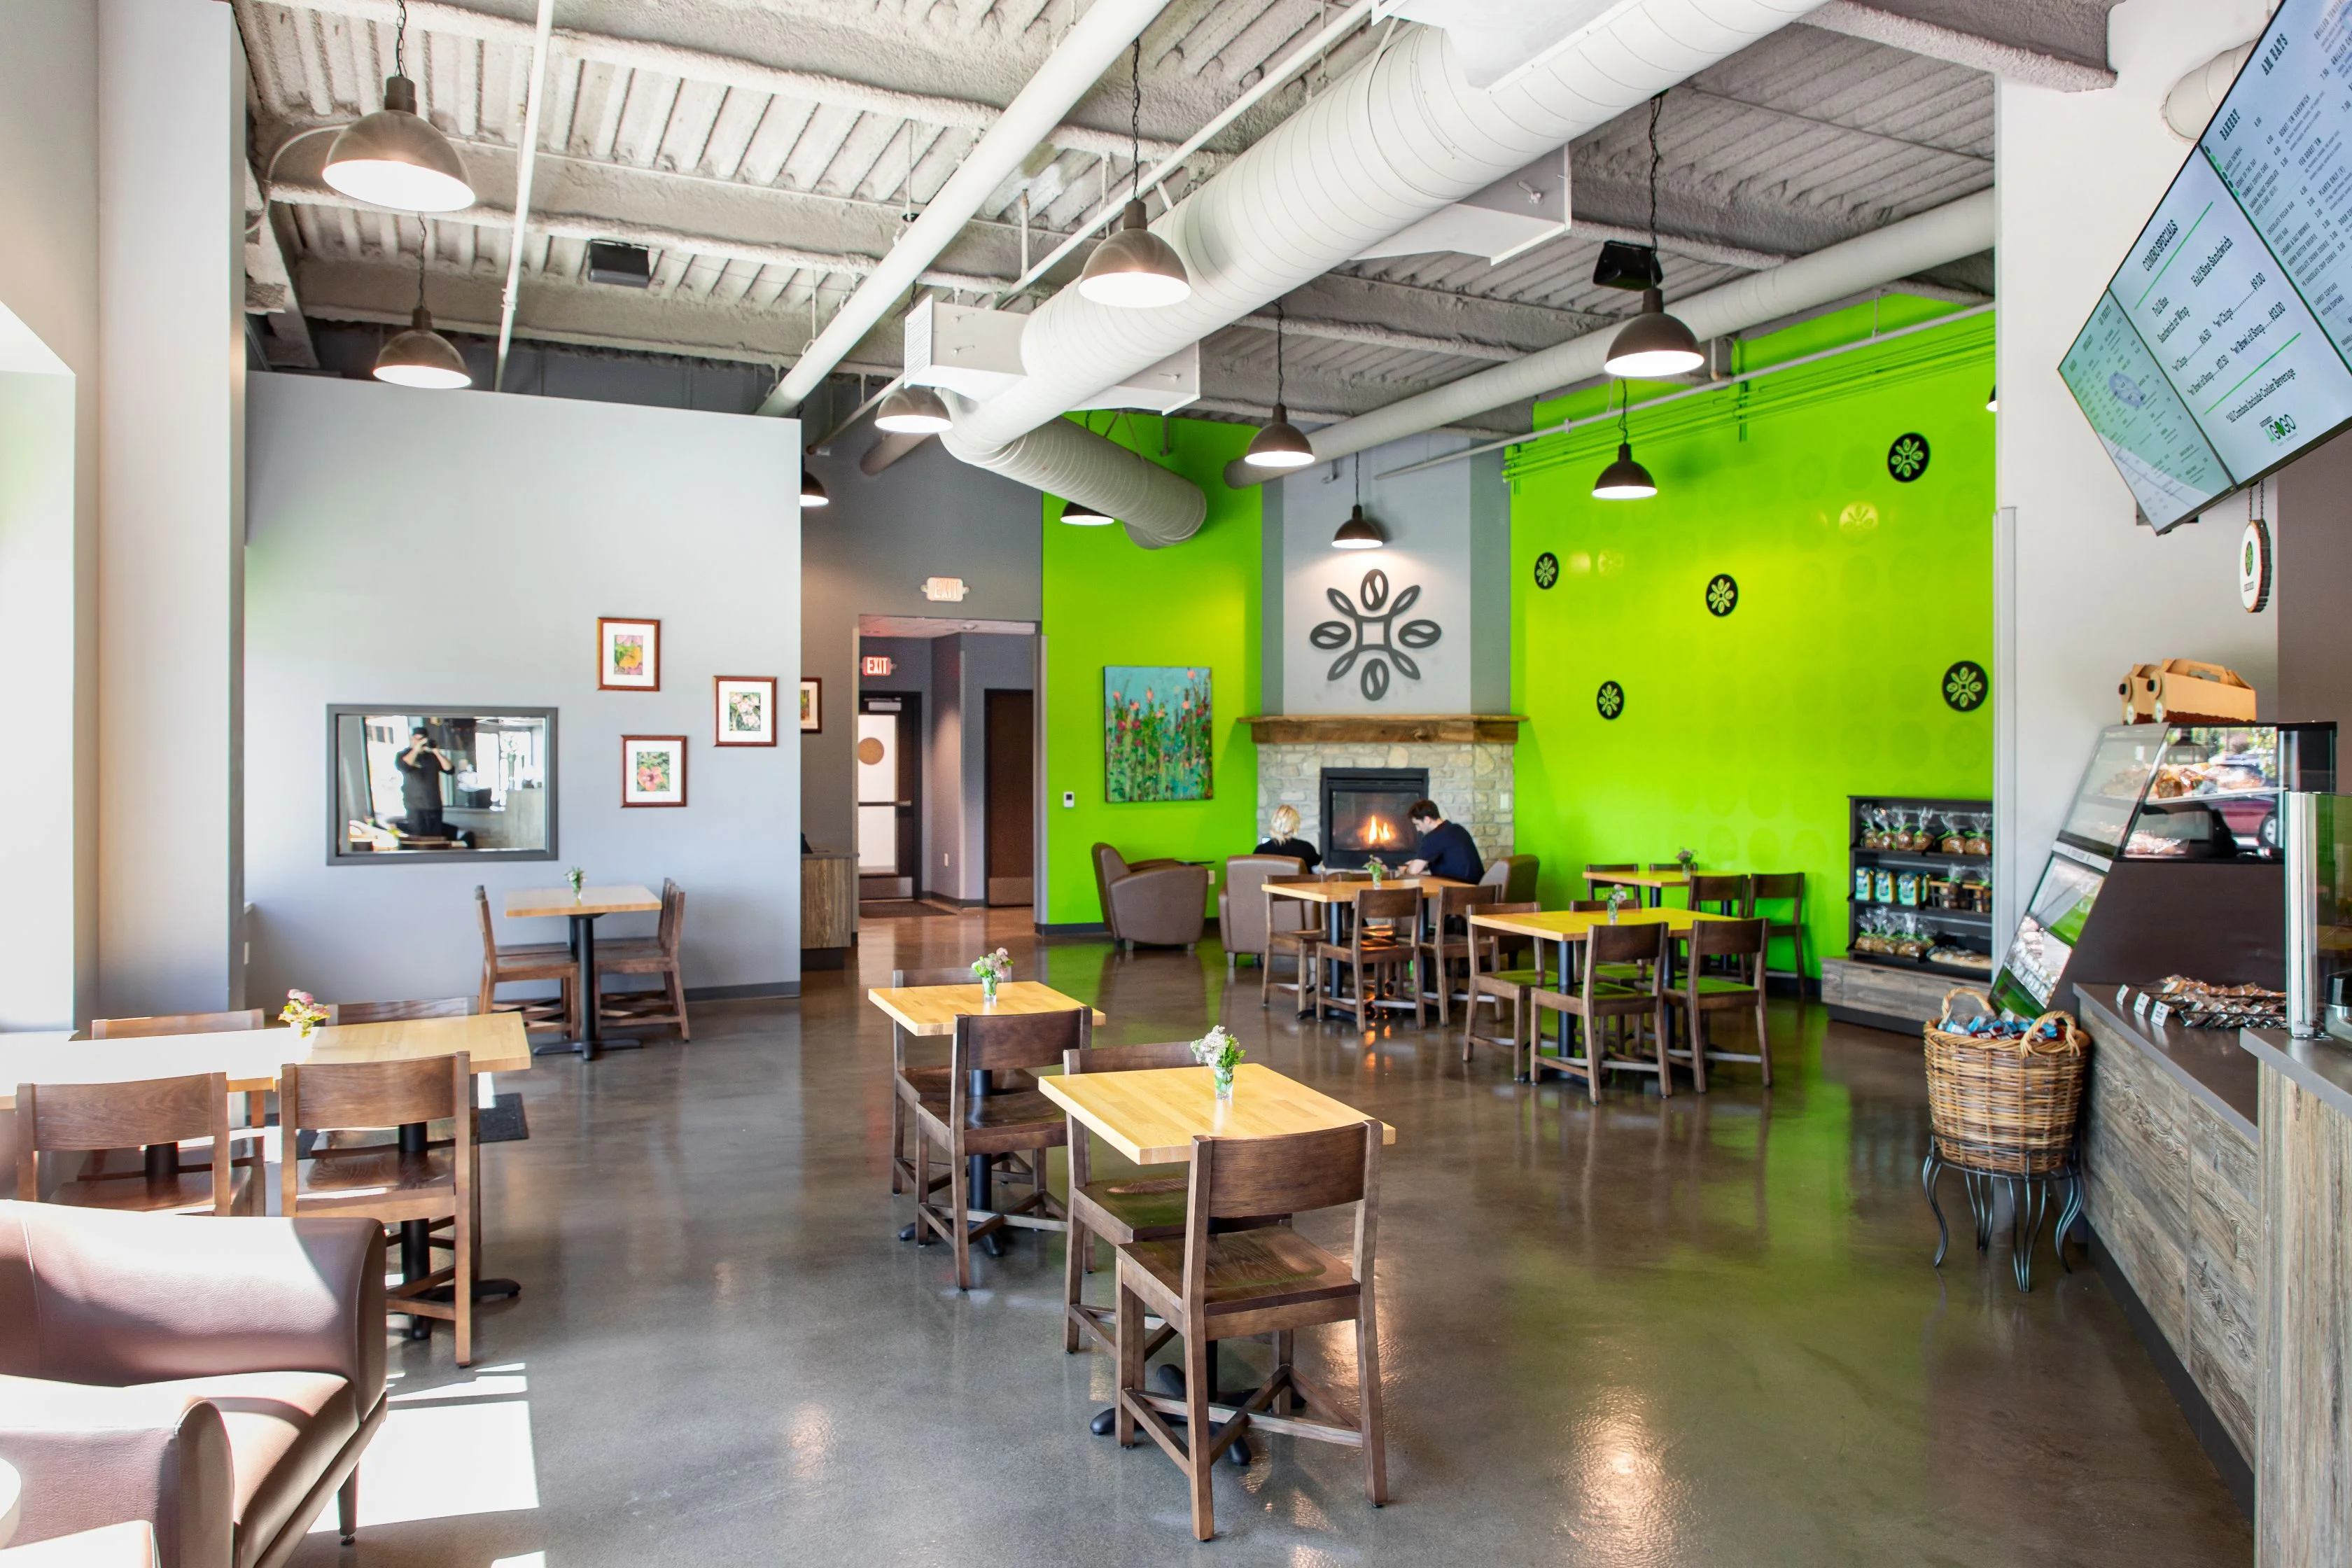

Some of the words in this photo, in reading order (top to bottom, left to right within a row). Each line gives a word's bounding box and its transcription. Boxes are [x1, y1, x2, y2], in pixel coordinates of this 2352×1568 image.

[2261, 56, 2274, 76] AM
[2269, 33, 2288, 61] EATS
[2331, 44, 2346, 65] GRILLED
[2292, 94, 2310, 118] SANDWICH
[2219, 108, 2240, 141] BAKERY
[2224, 160, 2233, 172] BAKED
[2231, 146, 2243, 162] OATMEAL
[2241, 183, 2254, 198] CRUMBLE
[2252, 171, 2262, 185] COFFEE
[2260, 162, 2269, 174] CAKE
[2264, 169, 2279, 188] CHOCOLATE
[2318, 181, 2331, 196] PLANTS
[2329, 172, 2338, 183] ONLY
[2253, 203, 2264, 216] COFFEE
[2262, 195, 2270, 206] CAKE
[2266, 217, 2281, 235] CHOCOLATE
[2279, 208, 2289, 219] PECAN
[2143, 246, 2160, 272] COMBO
[2155, 219, 2178, 253] SPECIALS
[2280, 243, 2292, 255] CARAMEL
[2297, 222, 2310, 237] BROWNIE
[2190, 269, 2204, 287] Half
[2199, 262, 2212, 276] Size
[2207, 236, 2233, 267] Sandwich
[2287, 254, 2297, 266] BROWN
[2295, 244, 2307, 257] BUTTER
[2295, 260, 2310, 276] CHOCOLATE
[2308, 251, 2318, 262] CHUNK
[2317, 240, 2329, 253] COOKIE
[2304, 267, 2320, 284] CHOCOLATE
[2325, 251, 2337, 264] COOKIE
[2314, 293, 2325, 306] CARROT
[2323, 282, 2337, 297] CUPCAKE
[2321, 305, 2332, 316] MOCHA
[2330, 294, 2344, 308] CUPCAKE
[2152, 302, 2162, 317] Full
[2157, 297, 2169, 309] Size
[2174, 307, 2190, 321] Wrap
[2157, 320, 2176, 344] Sandwich
[2173, 317, 2179, 326] or
[2236, 334, 2250, 351] Bowl
[2248, 330, 2255, 342] of
[2191, 379, 2202, 393] Bowl
[2200, 376, 2206, 386] of
[2232, 404, 2249, 419] Combos
[2245, 392, 2263, 409] Include
[2260, 383, 2276, 398] Cooler
[2272, 368, 2296, 388] Beverage
[933, 579, 958, 599] EXIT
[867, 657, 888, 674] EXIT
